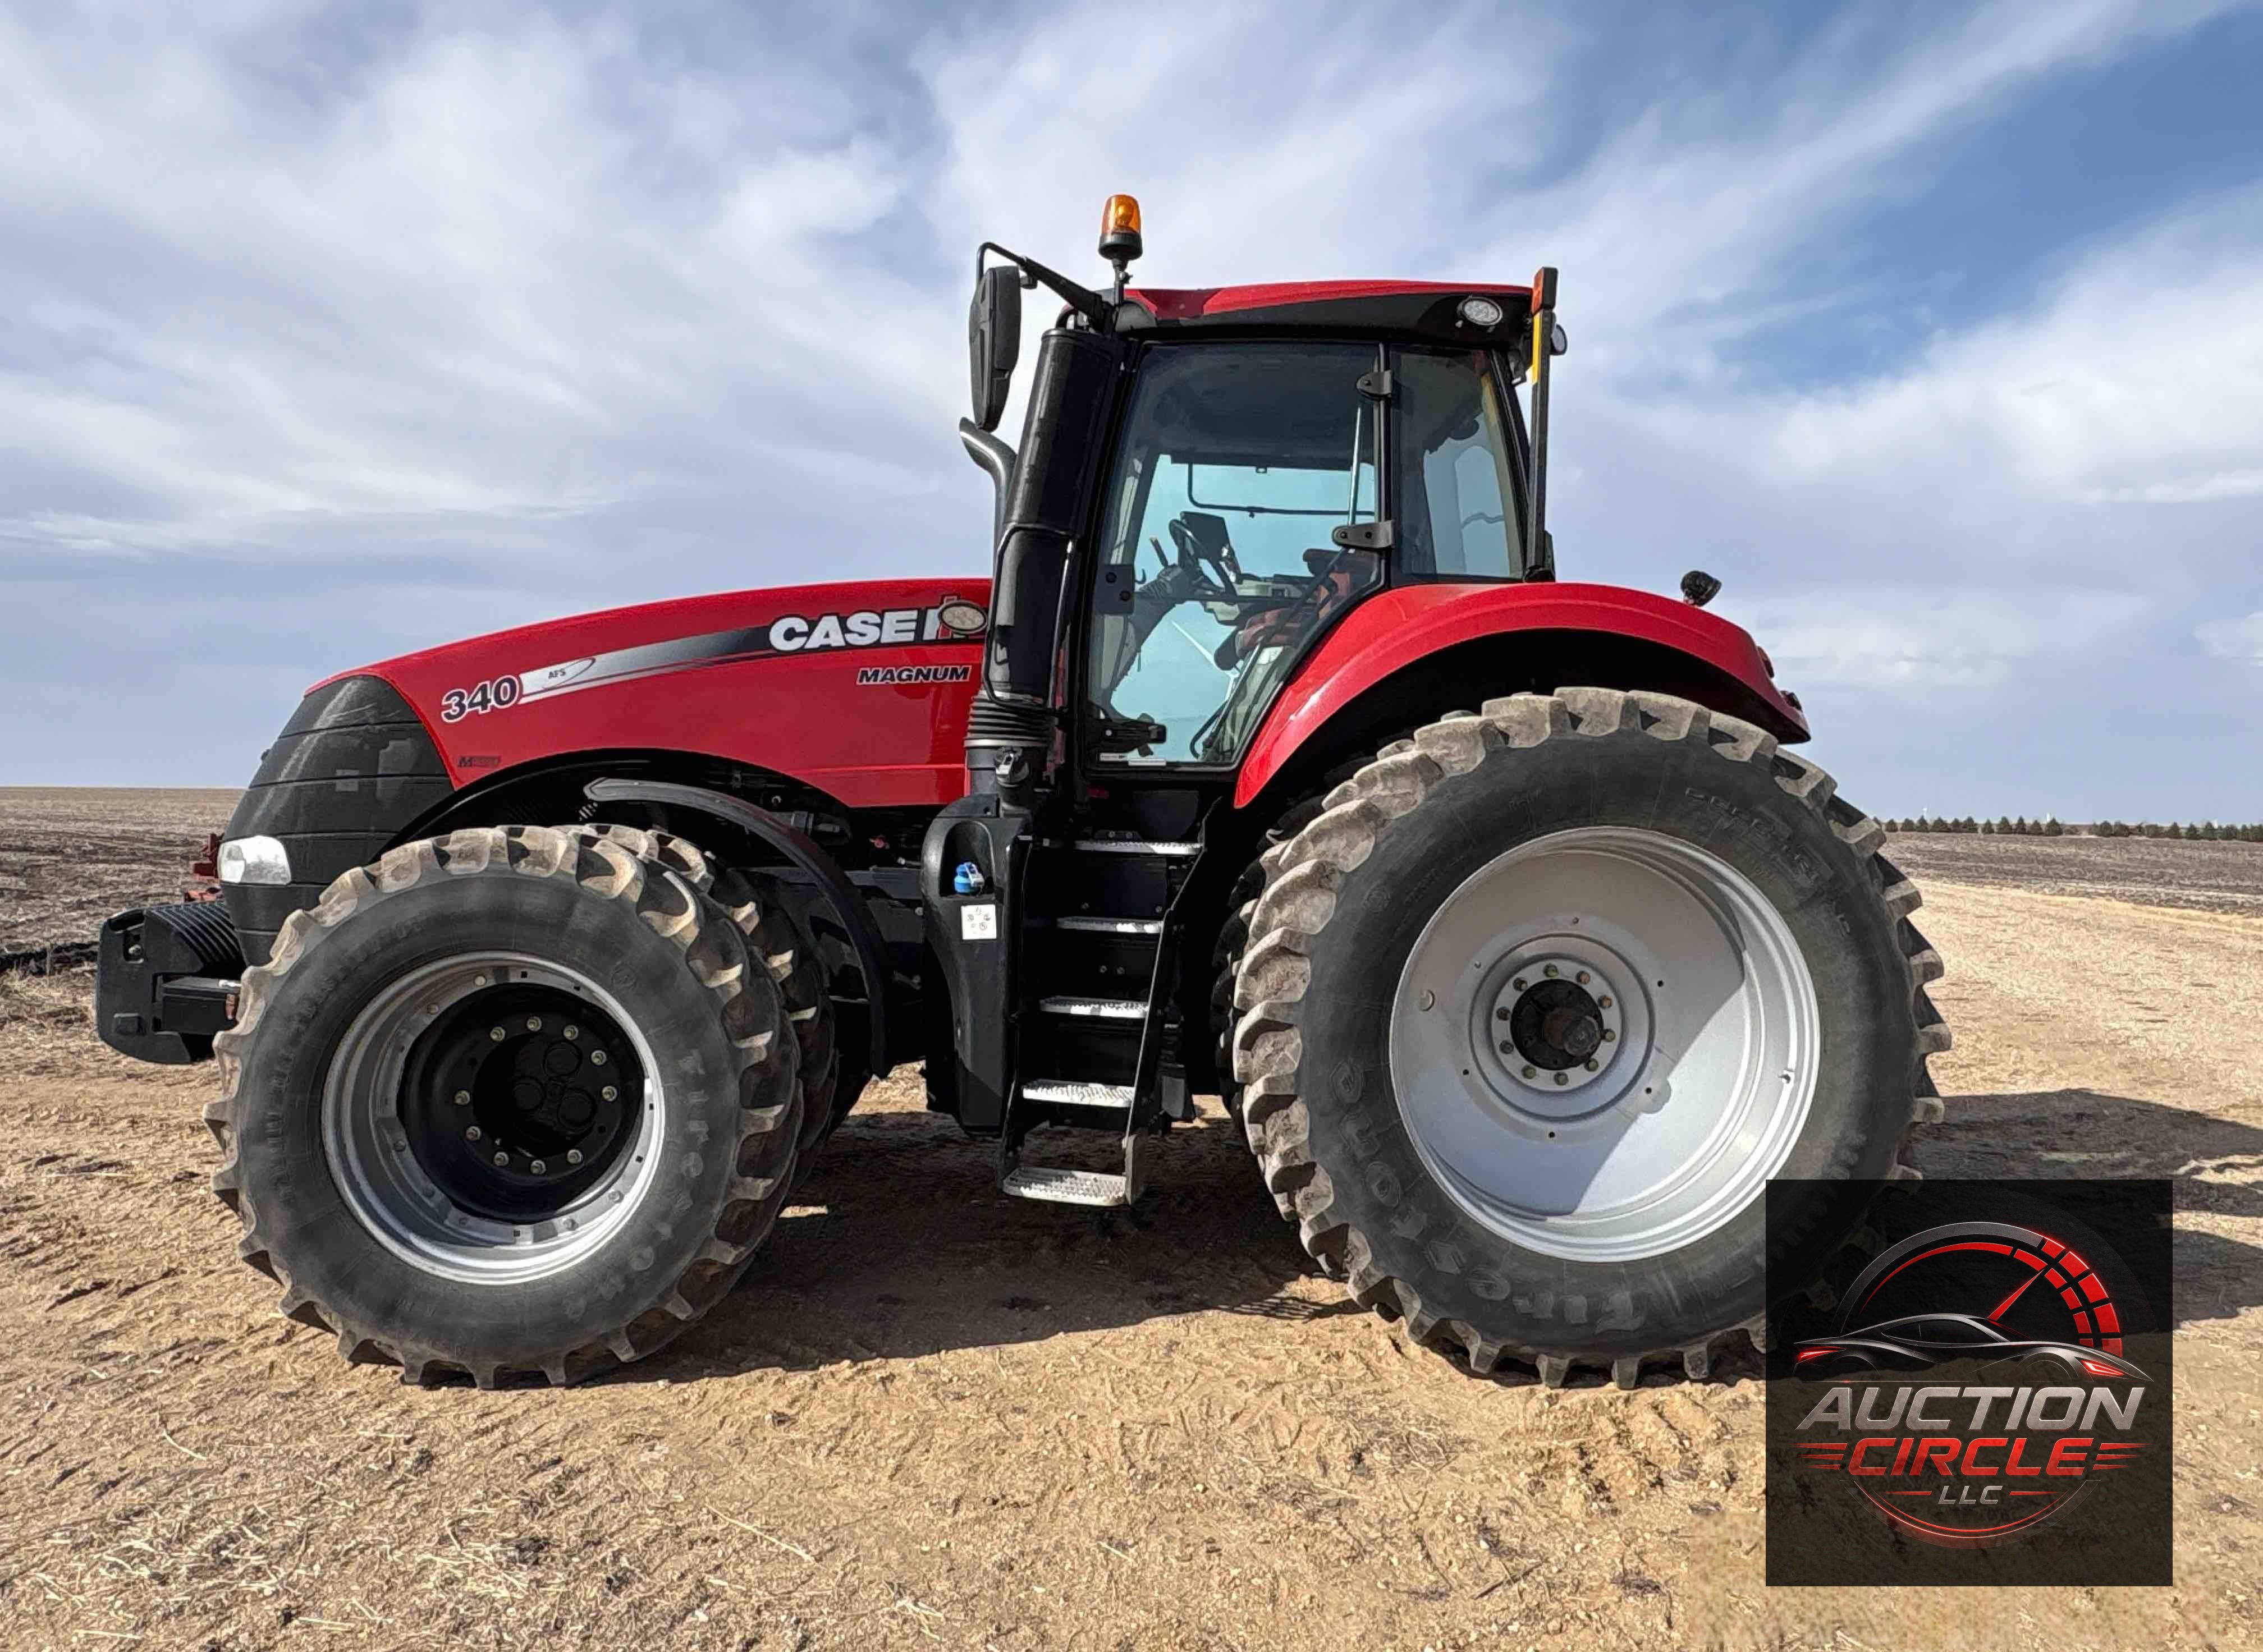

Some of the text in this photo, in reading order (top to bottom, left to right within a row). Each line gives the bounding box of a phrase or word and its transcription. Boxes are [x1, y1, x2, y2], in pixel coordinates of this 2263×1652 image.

[769, 609, 918, 651] CASE
[548, 668, 566, 679] AFS
[857, 666, 972, 684] MAGNUM
[441, 674, 519, 723] 340
